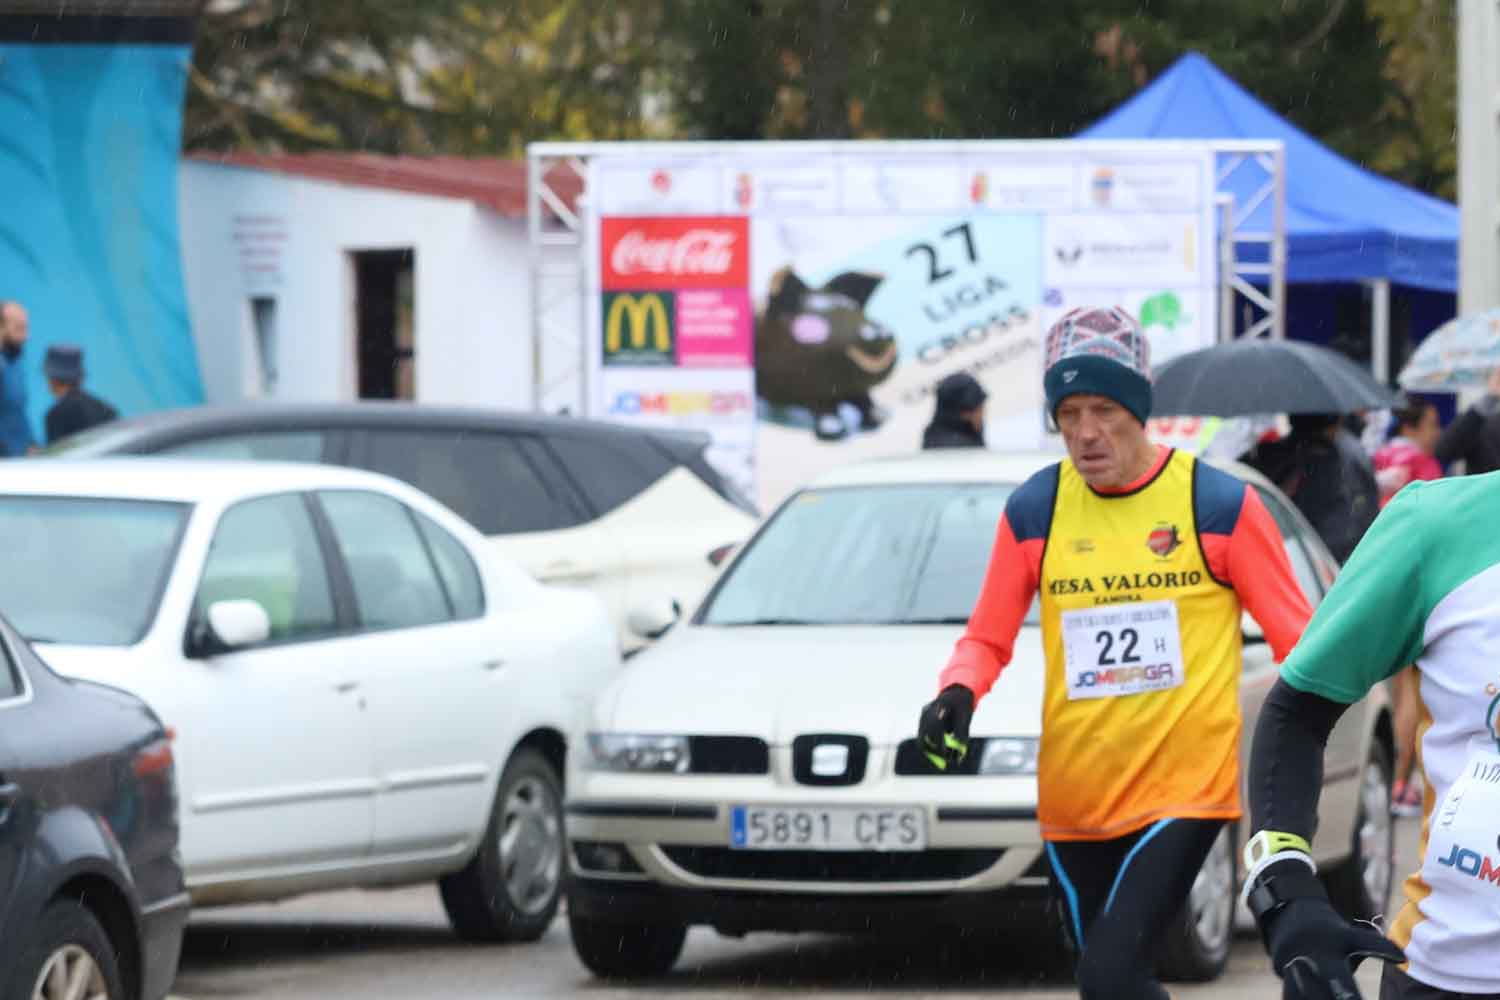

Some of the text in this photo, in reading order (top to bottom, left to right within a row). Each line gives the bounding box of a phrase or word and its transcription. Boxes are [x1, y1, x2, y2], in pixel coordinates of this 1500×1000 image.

[905, 221, 977, 285] 27
[922, 276, 1008, 323] LIGA
[1101, 570, 1202, 592] VALORIO
[1095, 627, 1142, 666] 22
[1154, 637, 1167, 653] H
[751, 811, 919, 844] 5891 CFS
